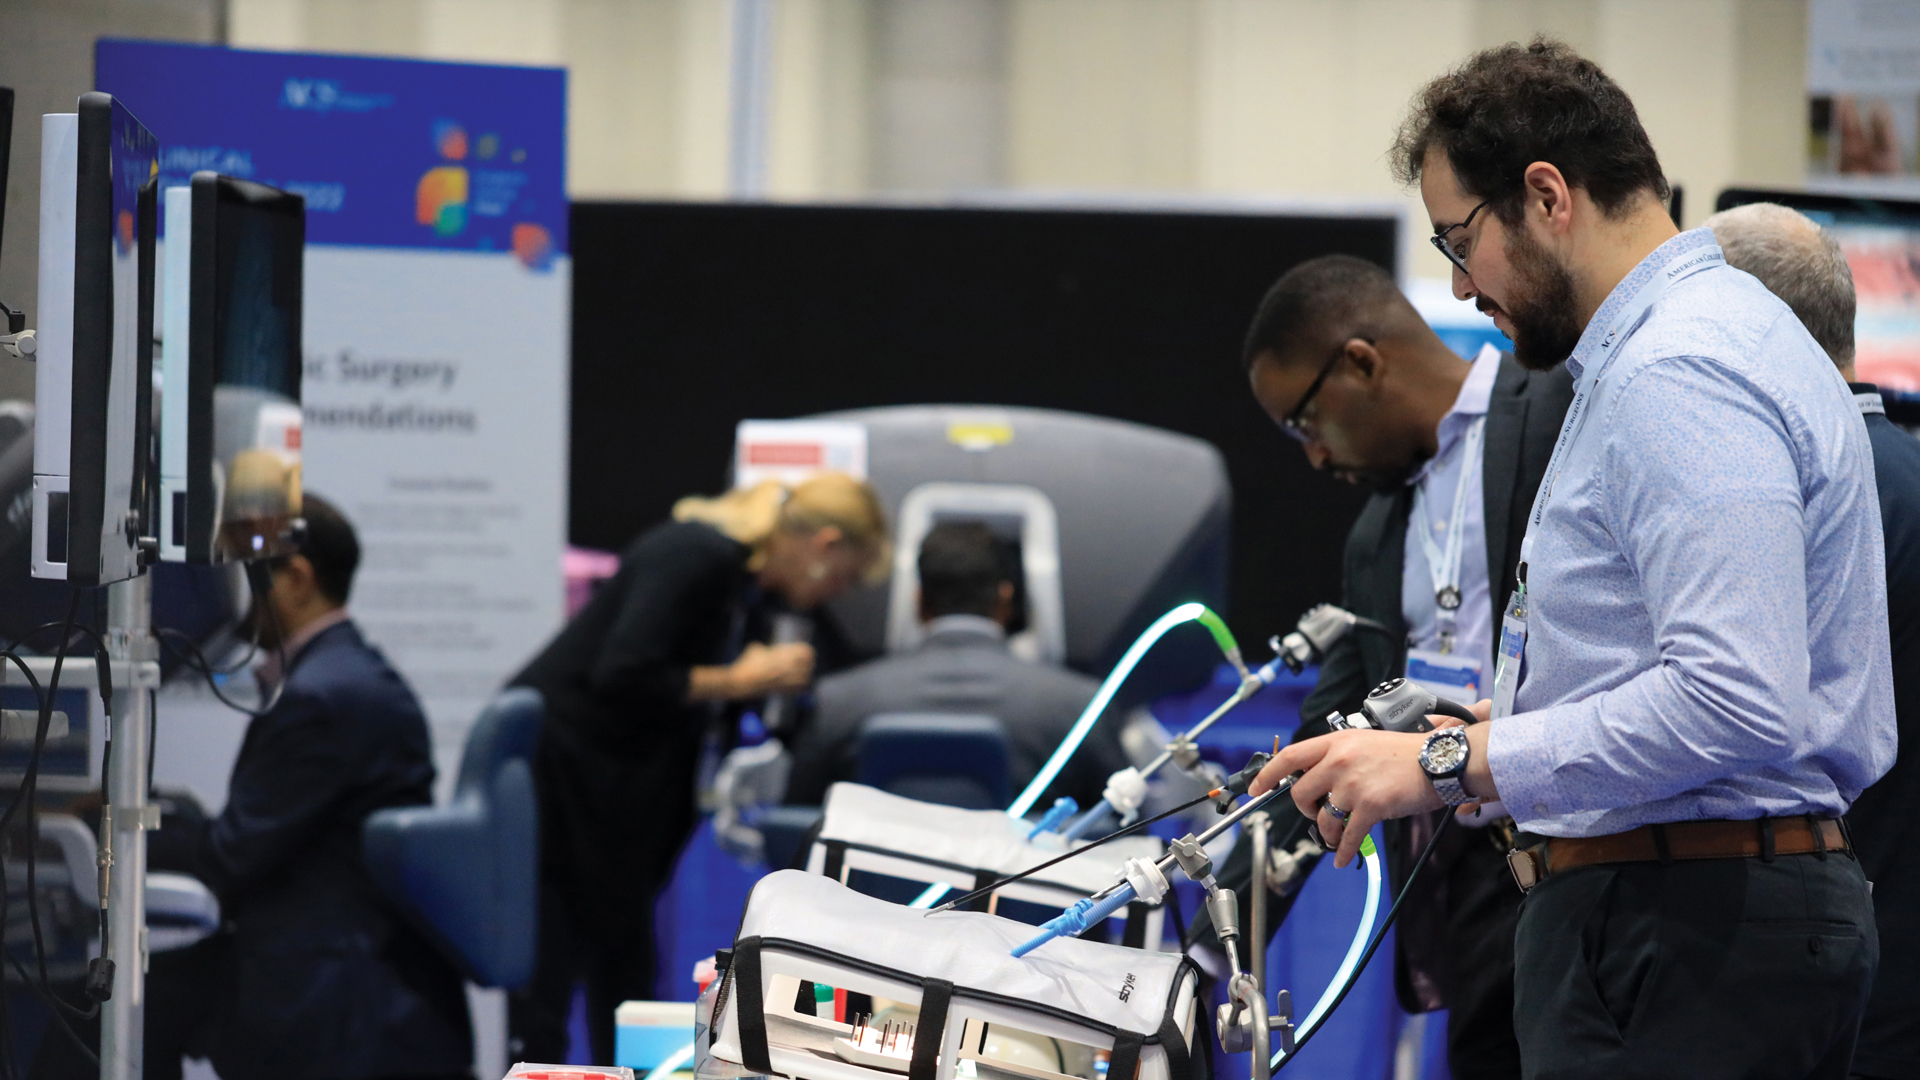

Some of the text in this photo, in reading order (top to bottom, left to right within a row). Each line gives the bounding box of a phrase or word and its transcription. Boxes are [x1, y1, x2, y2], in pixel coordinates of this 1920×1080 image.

[1666, 256, 1704, 280] AMERICAN
[1601, 329, 1616, 352] ACS
[337, 349, 459, 391] Surgery
[1534, 484, 1549, 527] AMERICAN
[1563, 392, 1585, 435] SURGEONS
[1388, 698, 1414, 720] stryker
[1118, 972, 1136, 1003] stryker
